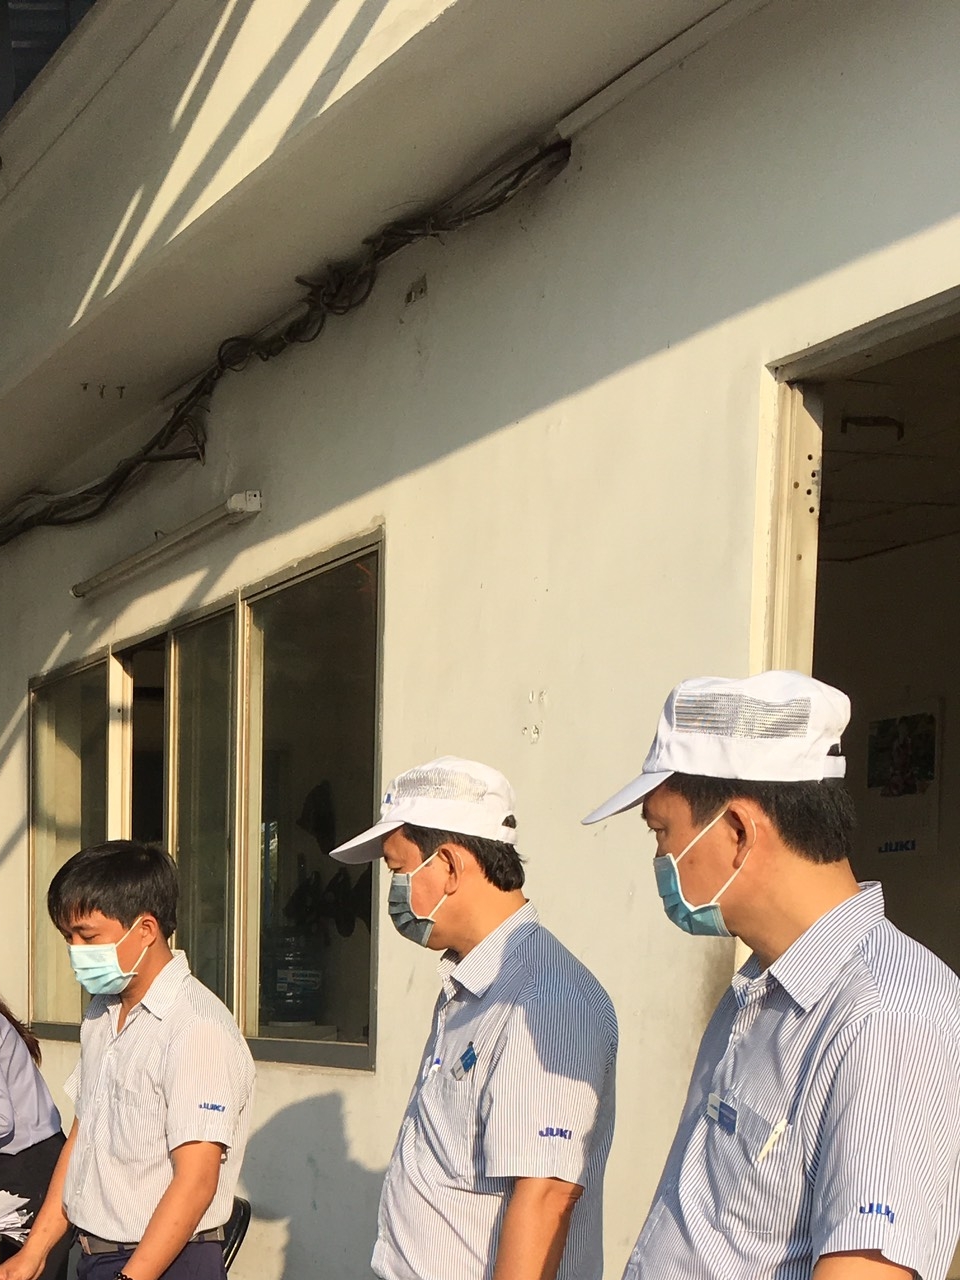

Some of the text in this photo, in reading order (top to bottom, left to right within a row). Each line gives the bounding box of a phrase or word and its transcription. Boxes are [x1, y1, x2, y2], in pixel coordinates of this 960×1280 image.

[878, 840, 916, 853] JUKI
[538, 1127, 572, 1140] JUKI
[859, 1202, 895, 1224] JUI
